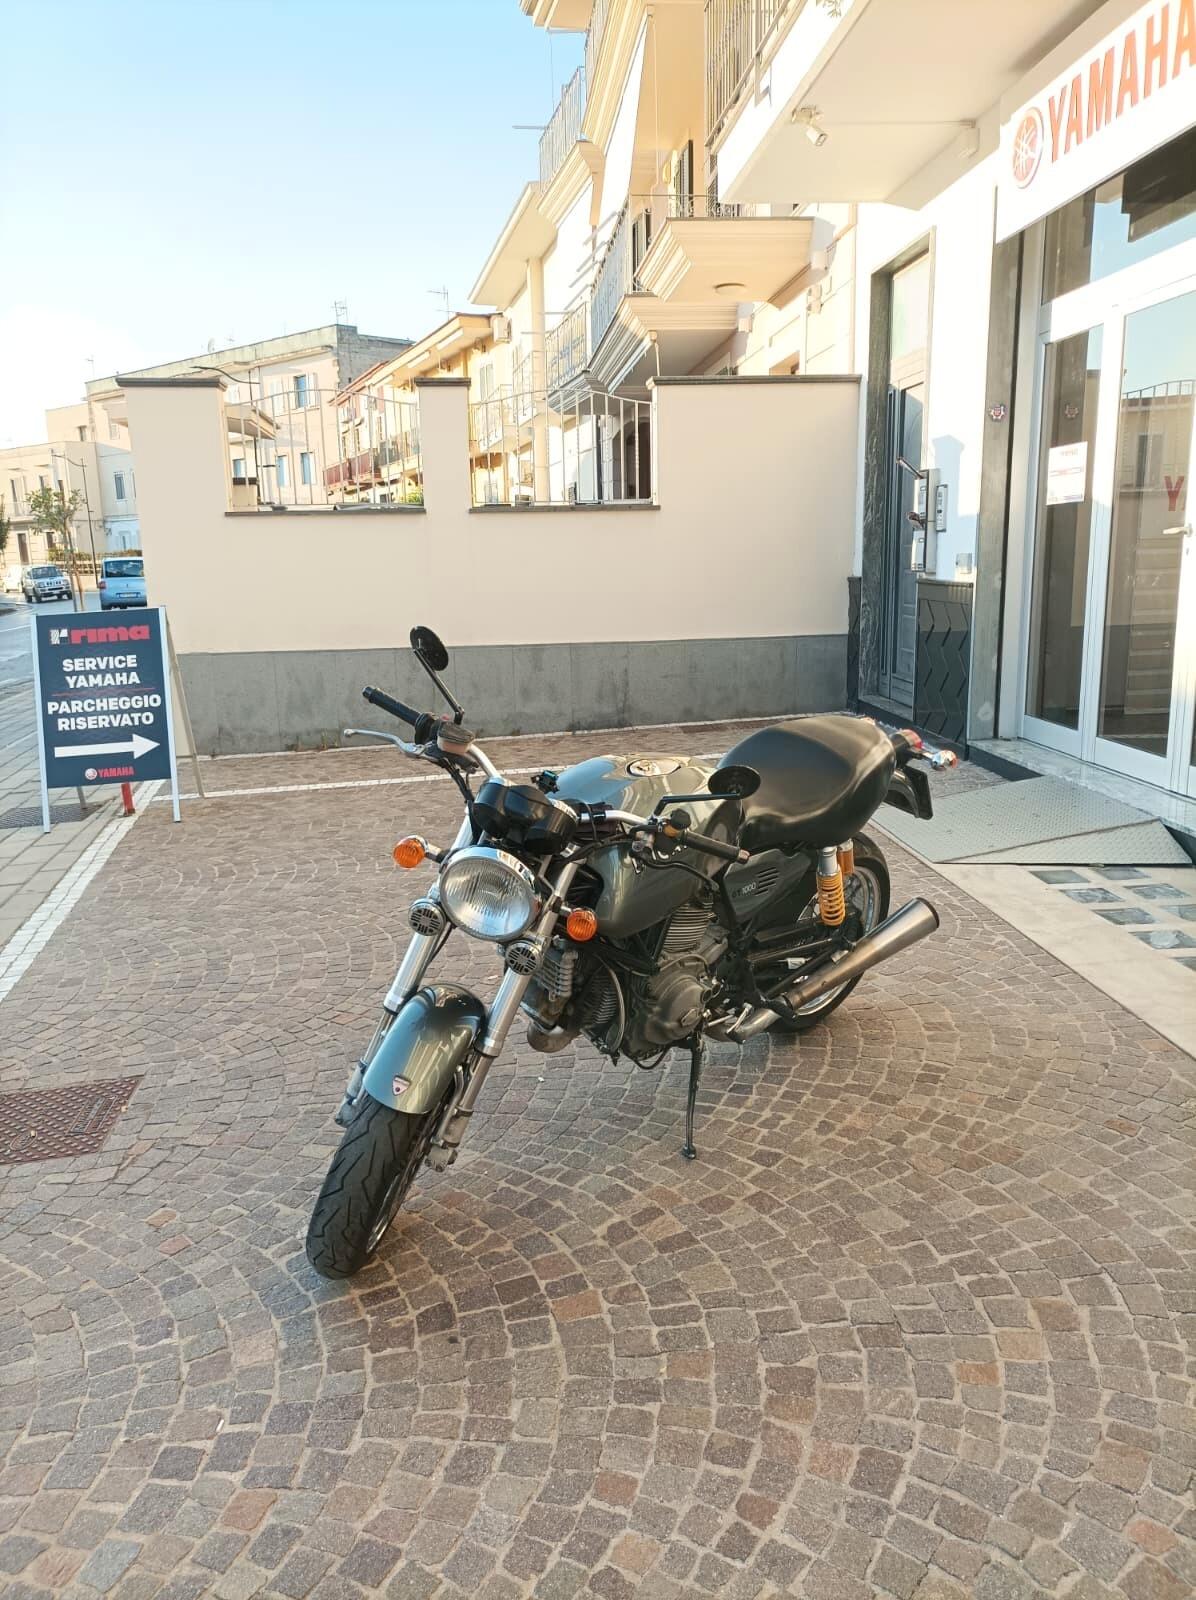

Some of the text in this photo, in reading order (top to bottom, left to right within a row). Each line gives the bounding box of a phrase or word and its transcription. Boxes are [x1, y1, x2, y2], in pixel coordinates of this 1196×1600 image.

[1048, 0, 1196, 164] YAMAHA
[1164, 475, 1185, 512] Y
[62, 654, 138, 673] SERVICE
[65, 672, 140, 689] YAMAHA
[47, 694, 162, 715] PARCHEGGIO
[57, 712, 154, 731] RISERVATO
[98, 766, 135, 777] YAMAHA
[742, 882, 757, 894] 1000
